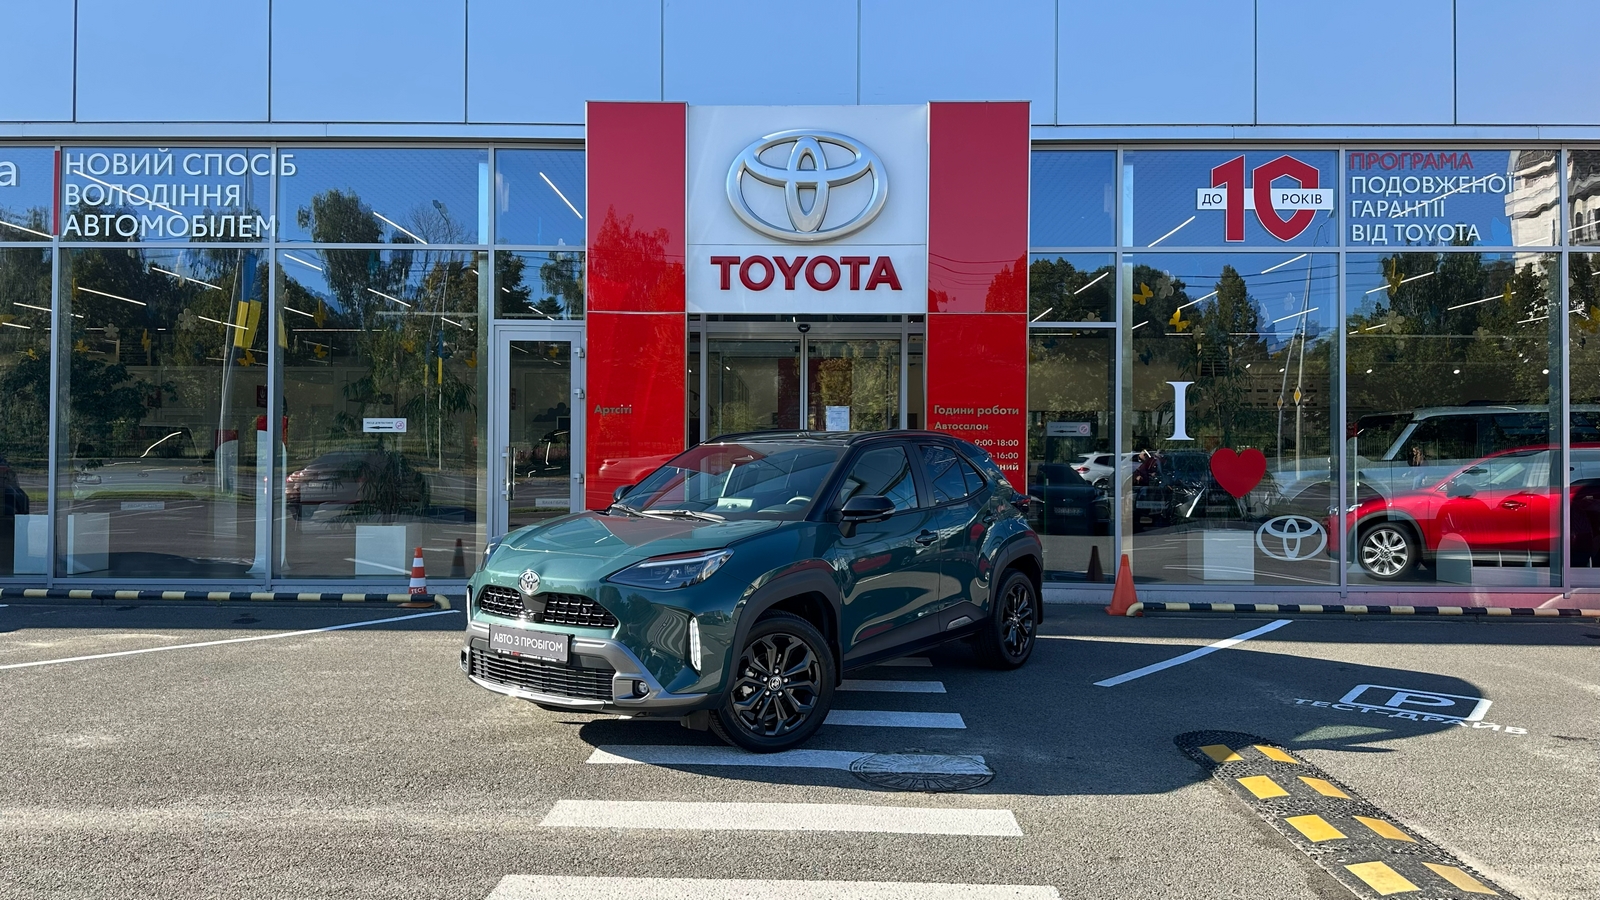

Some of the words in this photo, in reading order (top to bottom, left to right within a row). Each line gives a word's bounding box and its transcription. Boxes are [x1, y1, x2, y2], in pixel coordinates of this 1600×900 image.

[66, 148, 173, 176] НОВИЙ
[182, 153, 297, 177] СПОСІБ
[1350, 152, 1474, 171] ПРОГРАМА
[1351, 172, 1515, 197] ПОДОВЖЕНОЇ
[65, 183, 240, 210] ВОЛОДІННЯ
[1201, 193, 1223, 206] ДО
[1210, 153, 1320, 243] 10
[1281, 193, 1323, 205] РОКІВ
[1351, 197, 1445, 218] ГАРАНТІЇ
[62, 214, 276, 238] АВТОМОБІЛЕМ
[1351, 224, 1388, 244] ВІД
[1393, 223, 1482, 242] TOYOTA
[710, 255, 903, 291] TOYOTA
[594, 404, 633, 417] Артсіті
[934, 405, 974, 415] Години
[977, 404, 1019, 417] роботи
[1165, 381, 1195, 441] I
[934, 421, 989, 430] Автосалон
[493, 632, 513, 645] АВТО
[520, 636, 563, 653] ПРОБІГОМ
[1293, 698, 1529, 735] ТЕСТ-ДРАЙВ
